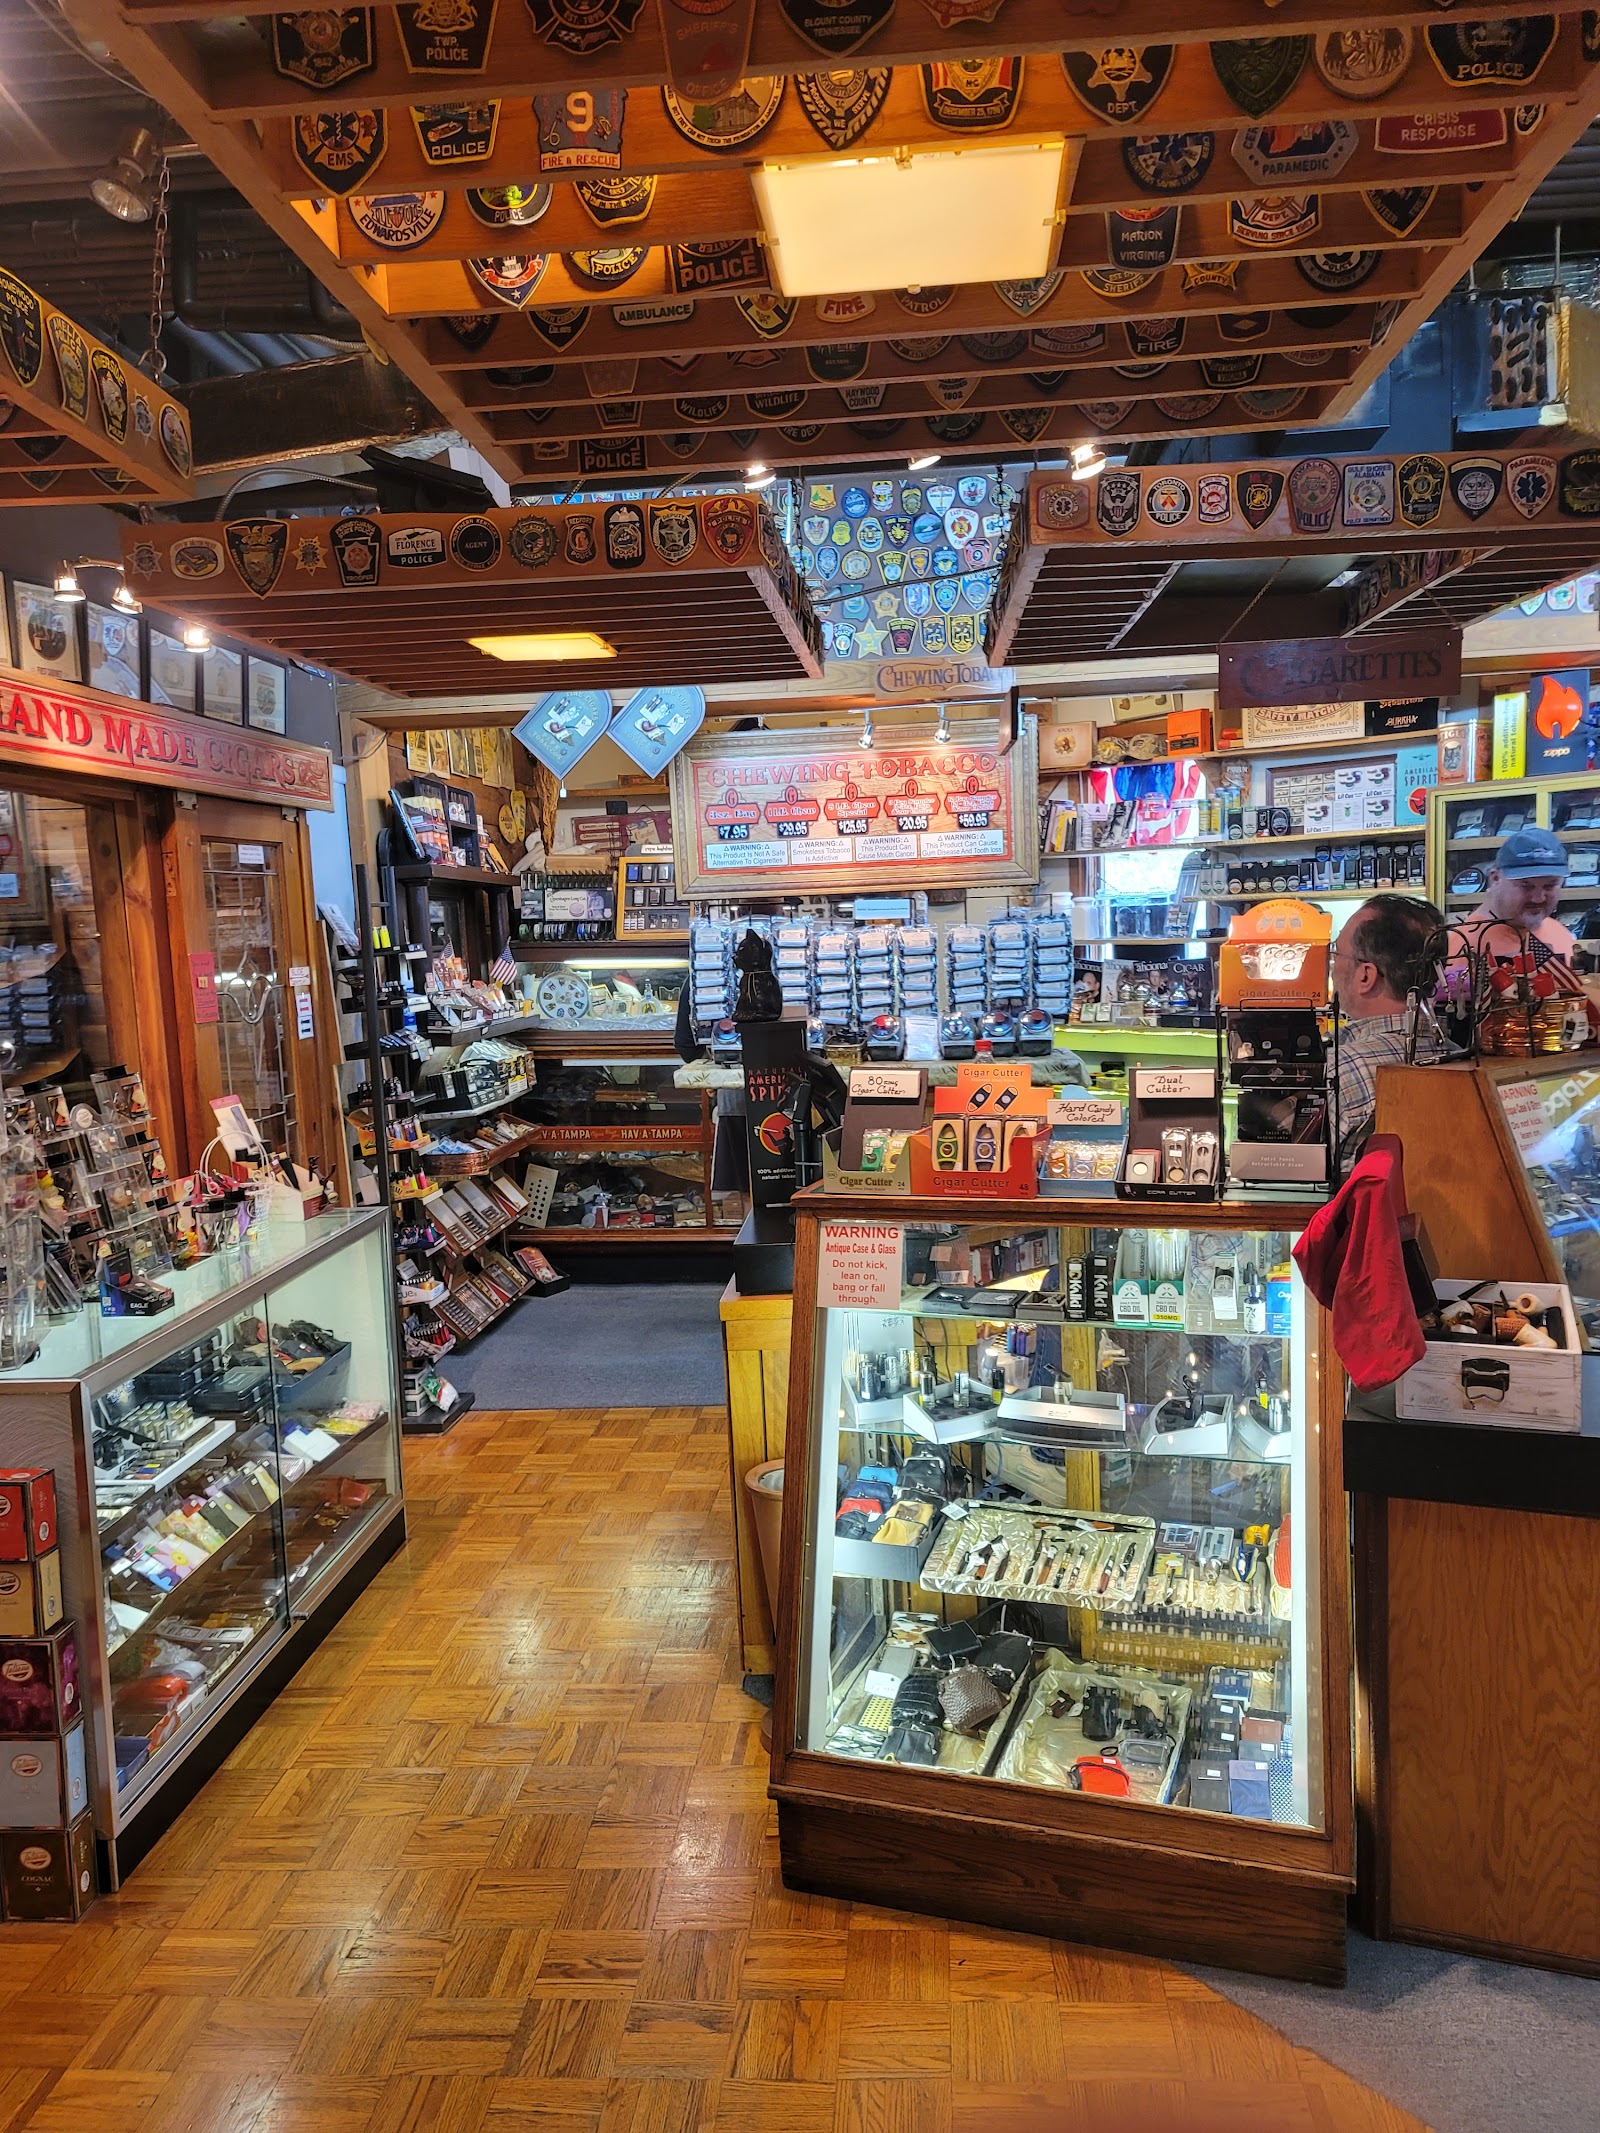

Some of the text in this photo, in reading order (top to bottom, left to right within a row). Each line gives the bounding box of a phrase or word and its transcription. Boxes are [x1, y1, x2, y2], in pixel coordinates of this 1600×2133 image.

[839, 15, 872, 26] COUNTY
[676, 21, 739, 41] SHERIFF'S
[813, 26, 862, 37] TENNESSEE
[433, 36, 460, 48] TWP.
[425, 47, 469, 62] POLICE
[1456, 62, 1526, 80] POLICE
[685, 77, 730, 96] OFFICE
[565, 90, 595, 133] 9
[1106, 100, 1139, 115] DEPT.
[1414, 111, 1461, 126] CRISIS
[1400, 124, 1477, 142] RESPONSE
[431, 140, 487, 159] POLICE
[326, 152, 355, 167] EMS
[541, 153, 620, 168] FIRE RESCUE
[1261, 158, 1330, 176] PARAMEDIC
[493, 208, 525, 223] POLICE
[358, 208, 437, 242] EDWARDSVILLE
[1120, 230, 1163, 243] MARION
[1119, 250, 1166, 262] VIRGINIA
[594, 254, 638, 275] POLICE
[1321, 261, 1353, 271] POLICE
[680, 256, 759, 289] POLICE
[1102, 275, 1147, 293] SHERIFF
[1193, 274, 1228, 286] COUNTY
[5, 293, 30, 316] POLICE
[822, 295, 867, 316] FIRE
[901, 295, 946, 313] PATROL
[618, 303, 692, 322] AMBULANCE
[1137, 337, 1179, 353] FIRE
[753, 390, 801, 409] WILDLIFE
[845, 386, 880, 400] HAYWOOD
[943, 391, 964, 401] 1802
[849, 396, 879, 408] COUNTY
[679, 400, 725, 419] WILDLIFE
[583, 450, 642, 470] POLICE
[1509, 458, 1556, 471] PARAMEDIC
[1347, 464, 1392, 474] GULF SHORES
[1152, 478, 1187, 492] TORONTO
[568, 517, 594, 525] REDFORD
[715, 516, 743, 524] POLICE
[1155, 512, 1181, 523] POLICE
[1295, 507, 1331, 528] POLICE
[395, 538, 437, 550] FLORENCE
[463, 540, 488, 549] AGENT
[400, 555, 434, 565] POLICE
[569, 550, 593, 560] POLICE
[875, 664, 956, 694] CHEWING
[1239, 649, 1444, 698] CIGARETTES
[1258, 708, 1296, 722] SAFETY
[0, 693, 297, 791] AND MADE CIGARS
[1509, 741, 1517, 768] natural
[705, 752, 998, 789] CHEWING TOBACCO
[1404, 773, 1438, 787] SPIRIT
[838, 818, 867, 834] $125.95
[898, 815, 929, 831] $20.95
[957, 812, 989, 828] $59.95
[719, 824, 749, 840] $7.95
[778, 821, 808, 837] $29.95
[804, 840, 839, 848] WARNING:
[867, 835, 903, 845] WARNING:
[944, 833, 979, 842] WARNING:
[729, 843, 765, 852] WARNING:
[861, 843, 912, 852] This Product Can
[925, 839, 999, 850] This Product Can Cause
[709, 852, 724, 860] This
[723, 851, 747, 861] Product
[792, 847, 851, 856] Smokeless Tobacco
[811, 854, 839, 862] Addictive
[857, 850, 916, 860] Cause Mouth Cancer
[922, 850, 937, 858] Gum
[936, 848, 961, 857] Disease
[961, 847, 973, 855] And
[973, 846, 990, 854] Tooth
[712, 859, 744, 867] Alternative
[753, 857, 784, 866] Cigarettes
[1237, 989, 1267, 999] Cigar
[1271, 989, 1307, 998] Cutter
[748, 1066, 802, 1076] NATURAL
[963, 1067, 1025, 1078] Cigar Cutter
[867, 1076, 884, 1087] 80
[1153, 1074, 1184, 1086] Dual
[851, 1083, 907, 1096] Cigar Cutter
[1146, 1084, 1191, 1095] Cutter
[1055, 1102, 1117, 1117] Hard Candy
[1066, 1112, 1106, 1124] Colored
[839, 1175, 894, 1189] Cigar Cutter
[932, 1176, 1029, 1191] Cigar Cutter 48
[824, 1225, 899, 1240] WARNING
[825, 1242, 897, 1256] Antique Case & Glass
[832, 1259, 888, 1271] Do not kick,
[840, 1271, 878, 1282] lean on,
[832, 1282, 886, 1294] bang or fall
[129, 1301, 150, 1310] EAGLE
[838, 1294, 879, 1306] through.
[1119, 1305, 1142, 1313] CBD OIL
[1155, 1305, 1178, 1313] CBD OIL
[20, 1875, 54, 1884] COGNAC
